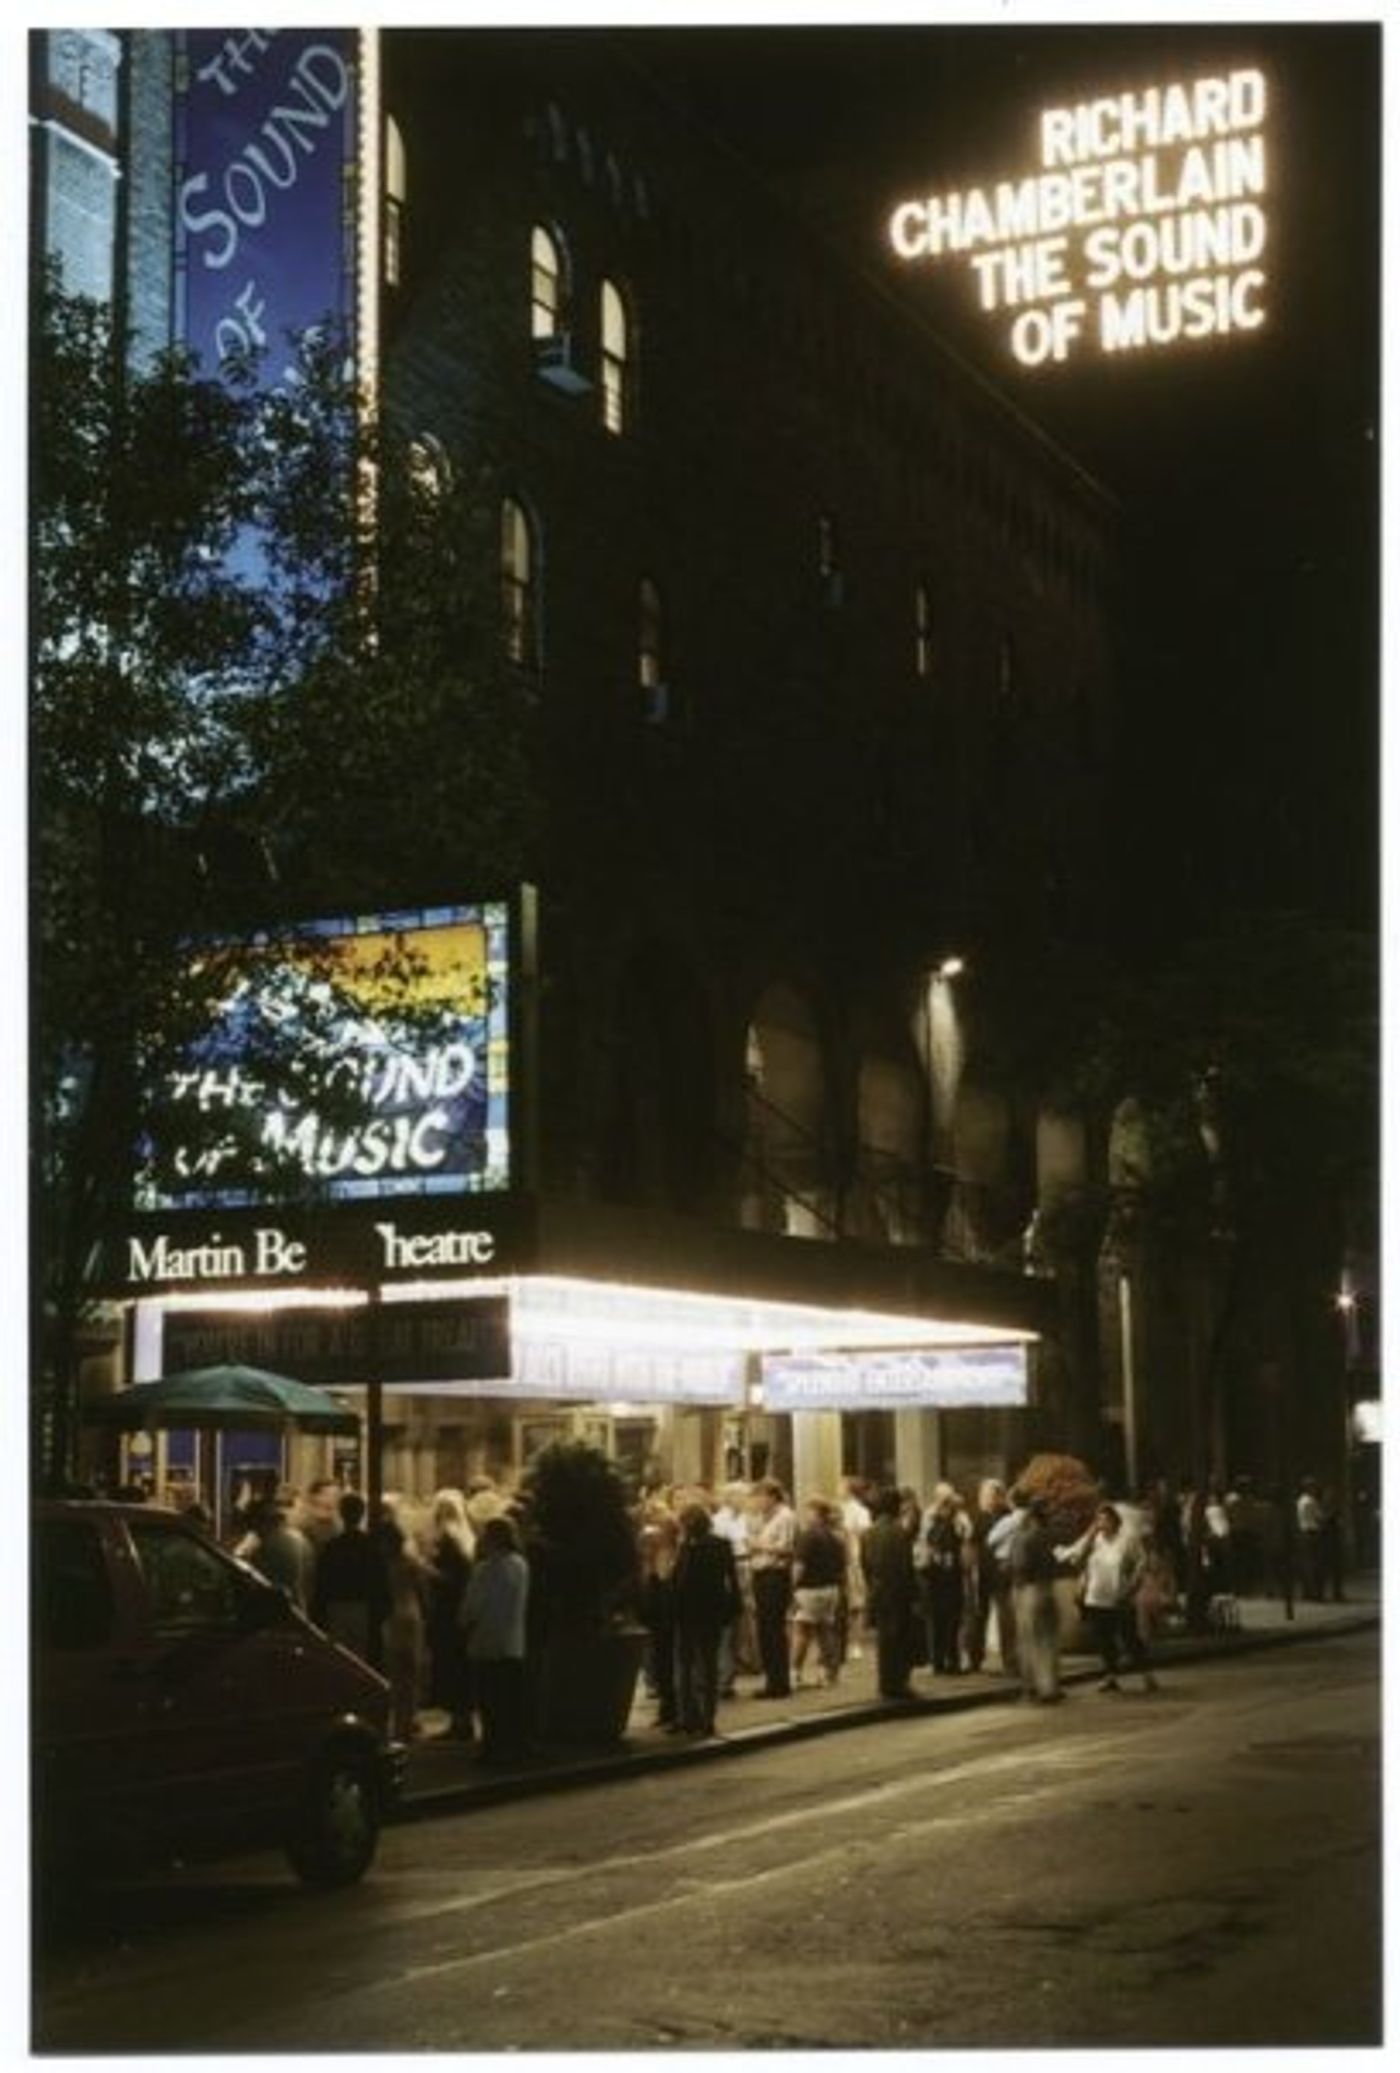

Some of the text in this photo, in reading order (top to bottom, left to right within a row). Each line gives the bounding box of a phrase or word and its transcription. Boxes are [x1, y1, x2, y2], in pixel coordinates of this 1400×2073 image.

[198, 28, 279, 95] TH
[181, 44, 348, 269] SOUND
[1040, 69, 1266, 167] RICHARD
[890, 136, 1266, 258] CHAMBERLAIN
[971, 203, 1266, 310] THE SOUND
[216, 279, 265, 358] OF
[1011, 269, 1266, 366] OF MUSIC
[254, 1109, 449, 1175] MUSIC
[128, 1234, 244, 1282] Martin
[255, 1228, 306, 1274] Be
